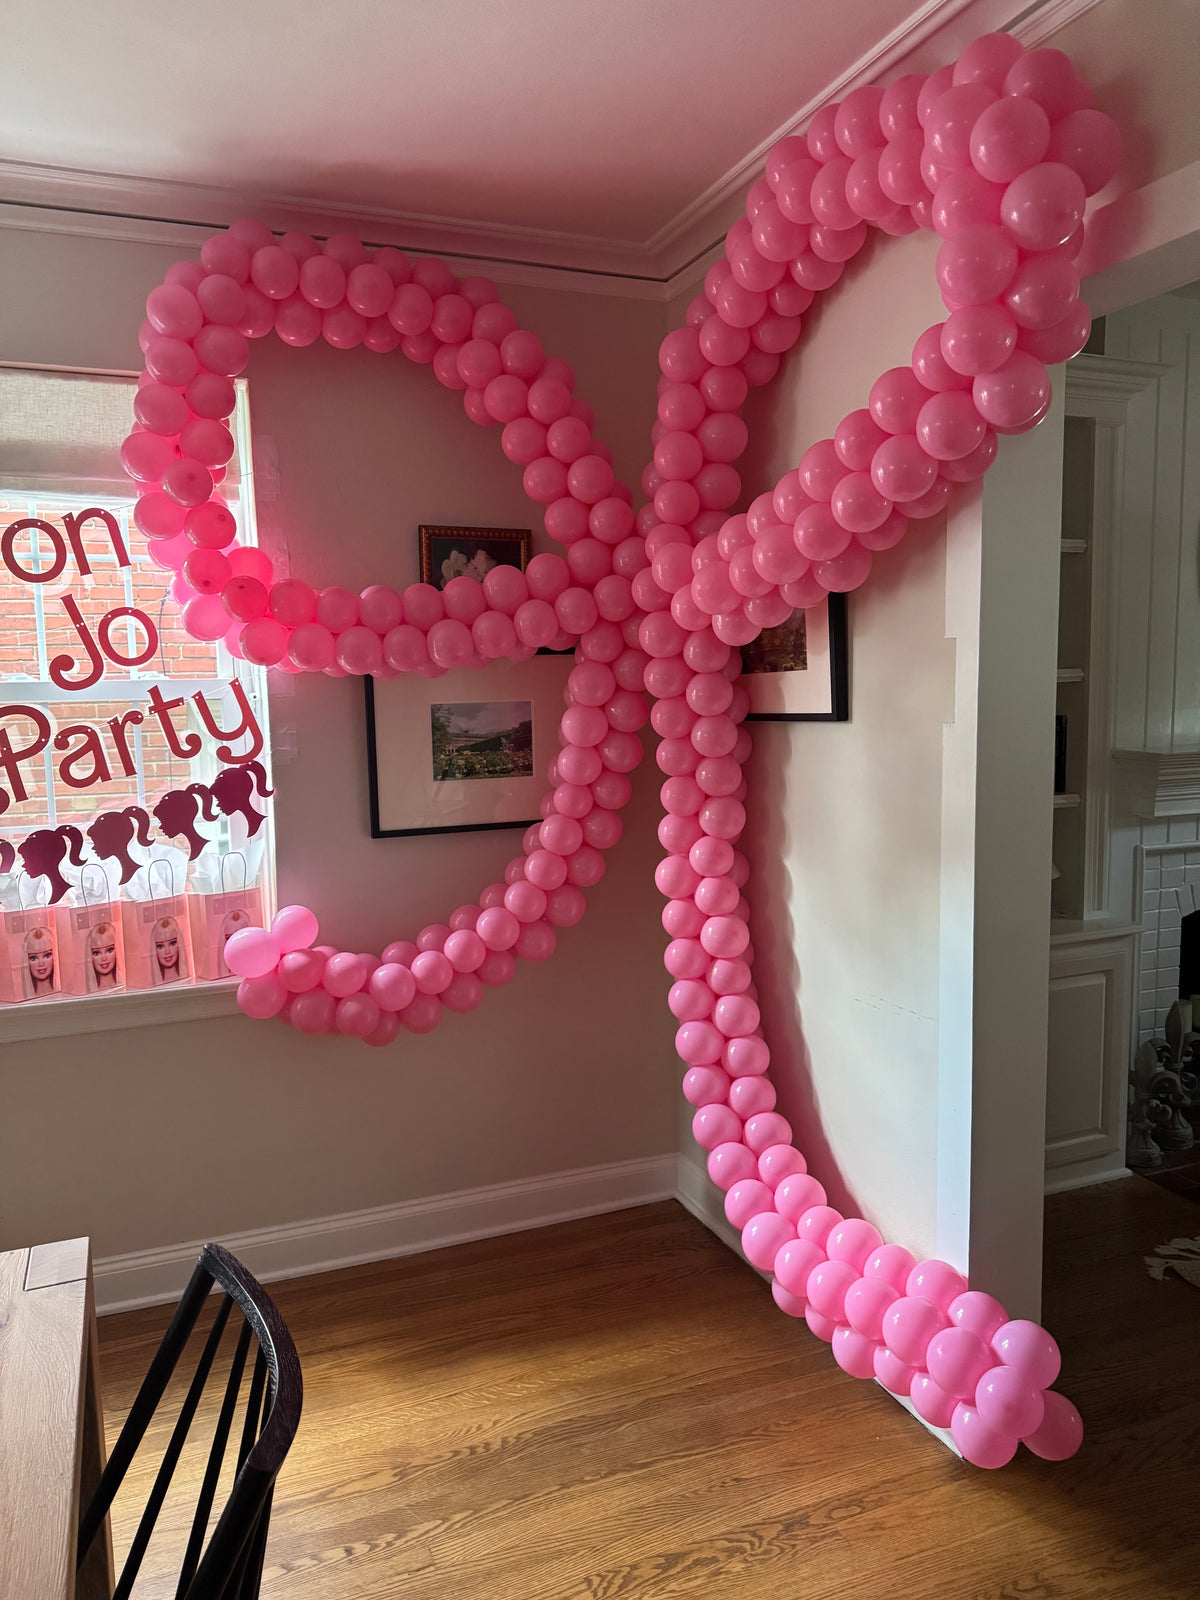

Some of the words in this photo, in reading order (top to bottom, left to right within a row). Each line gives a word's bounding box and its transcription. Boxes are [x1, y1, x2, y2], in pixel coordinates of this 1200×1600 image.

[1, 507, 131, 583] on
[49, 593, 158, 691] Jo
[0, 677, 264, 804] Party
